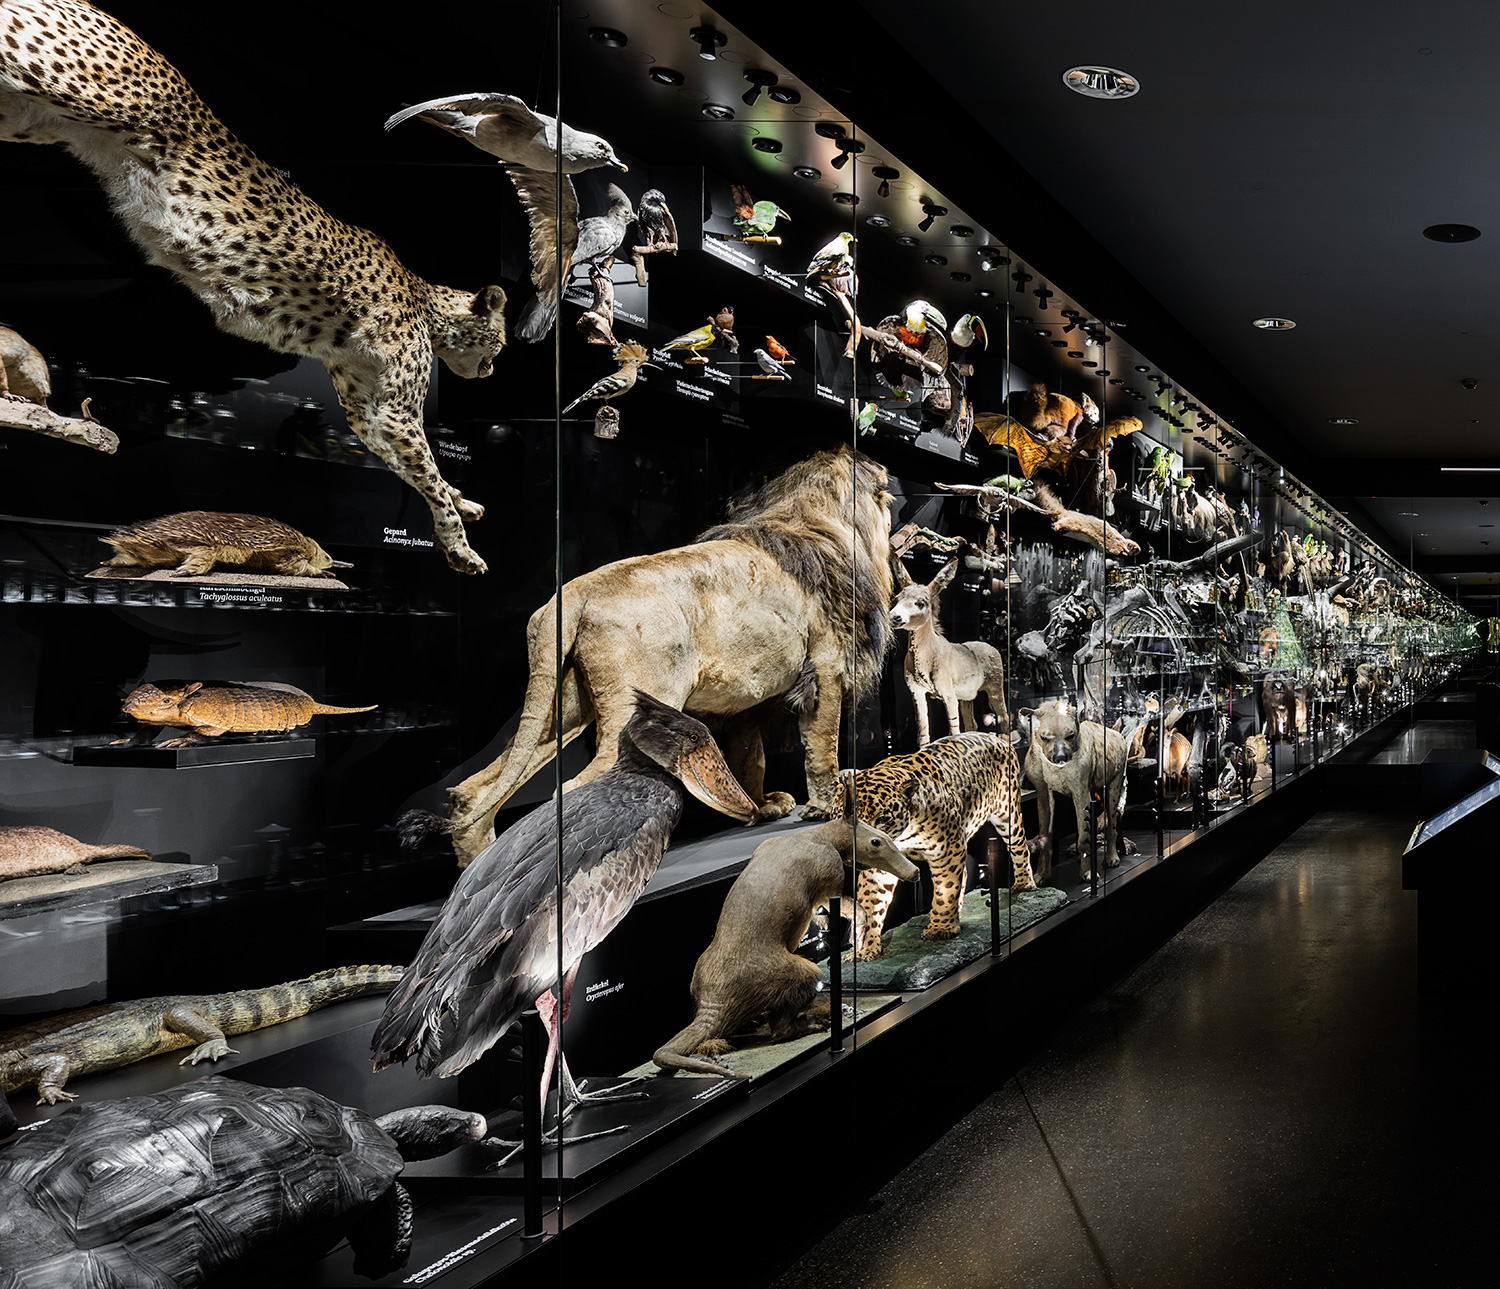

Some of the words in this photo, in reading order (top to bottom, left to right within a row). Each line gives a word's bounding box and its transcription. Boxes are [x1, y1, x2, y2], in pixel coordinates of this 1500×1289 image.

[383, 527, 407, 538] Gepard
[382, 536, 411, 546] Acinonyx
[199, 592, 247, 603] Tachyglossus
[248, 594, 283, 602] aculeatus
